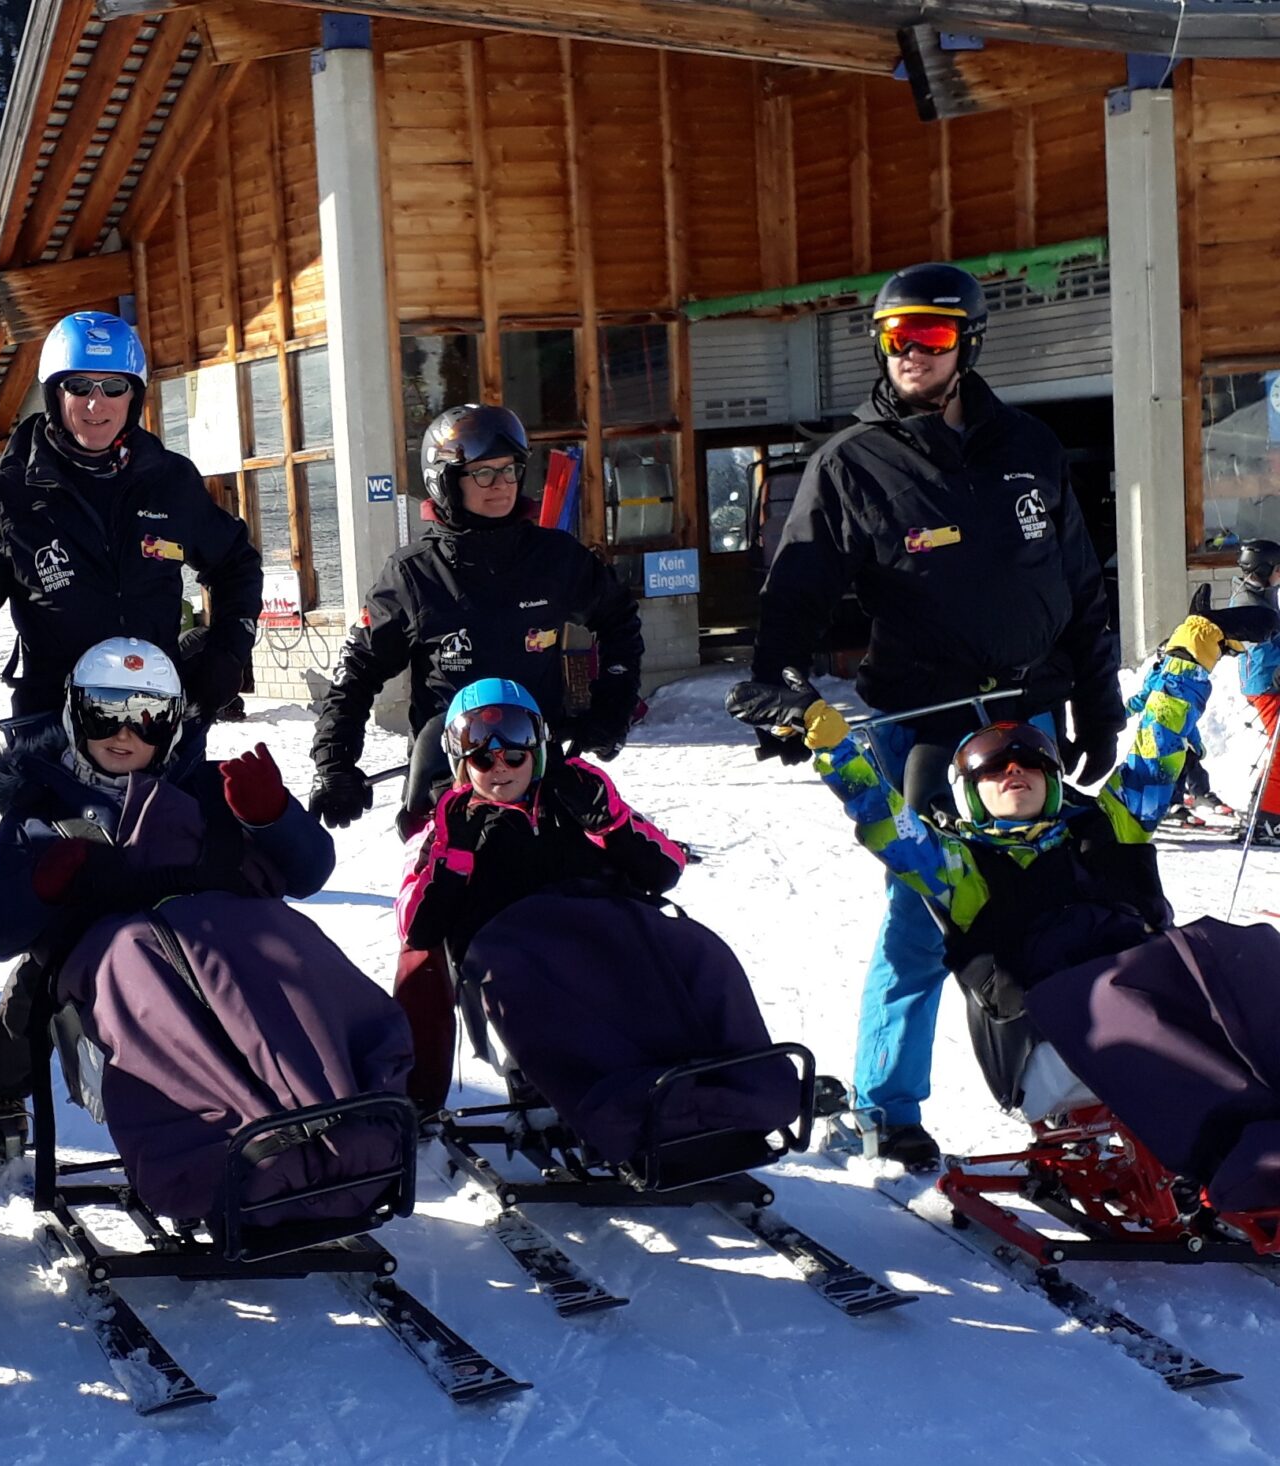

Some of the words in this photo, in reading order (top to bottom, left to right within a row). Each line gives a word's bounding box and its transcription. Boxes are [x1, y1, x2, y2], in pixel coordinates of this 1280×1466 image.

[368, 478, 392, 493] WC
[659, 556, 686, 571] Kein
[38, 565, 62, 578] HAUTE
[41, 569, 75, 585] PRESSION
[44, 578, 71, 593] SPORTS
[649, 573, 696, 590] Eingang
